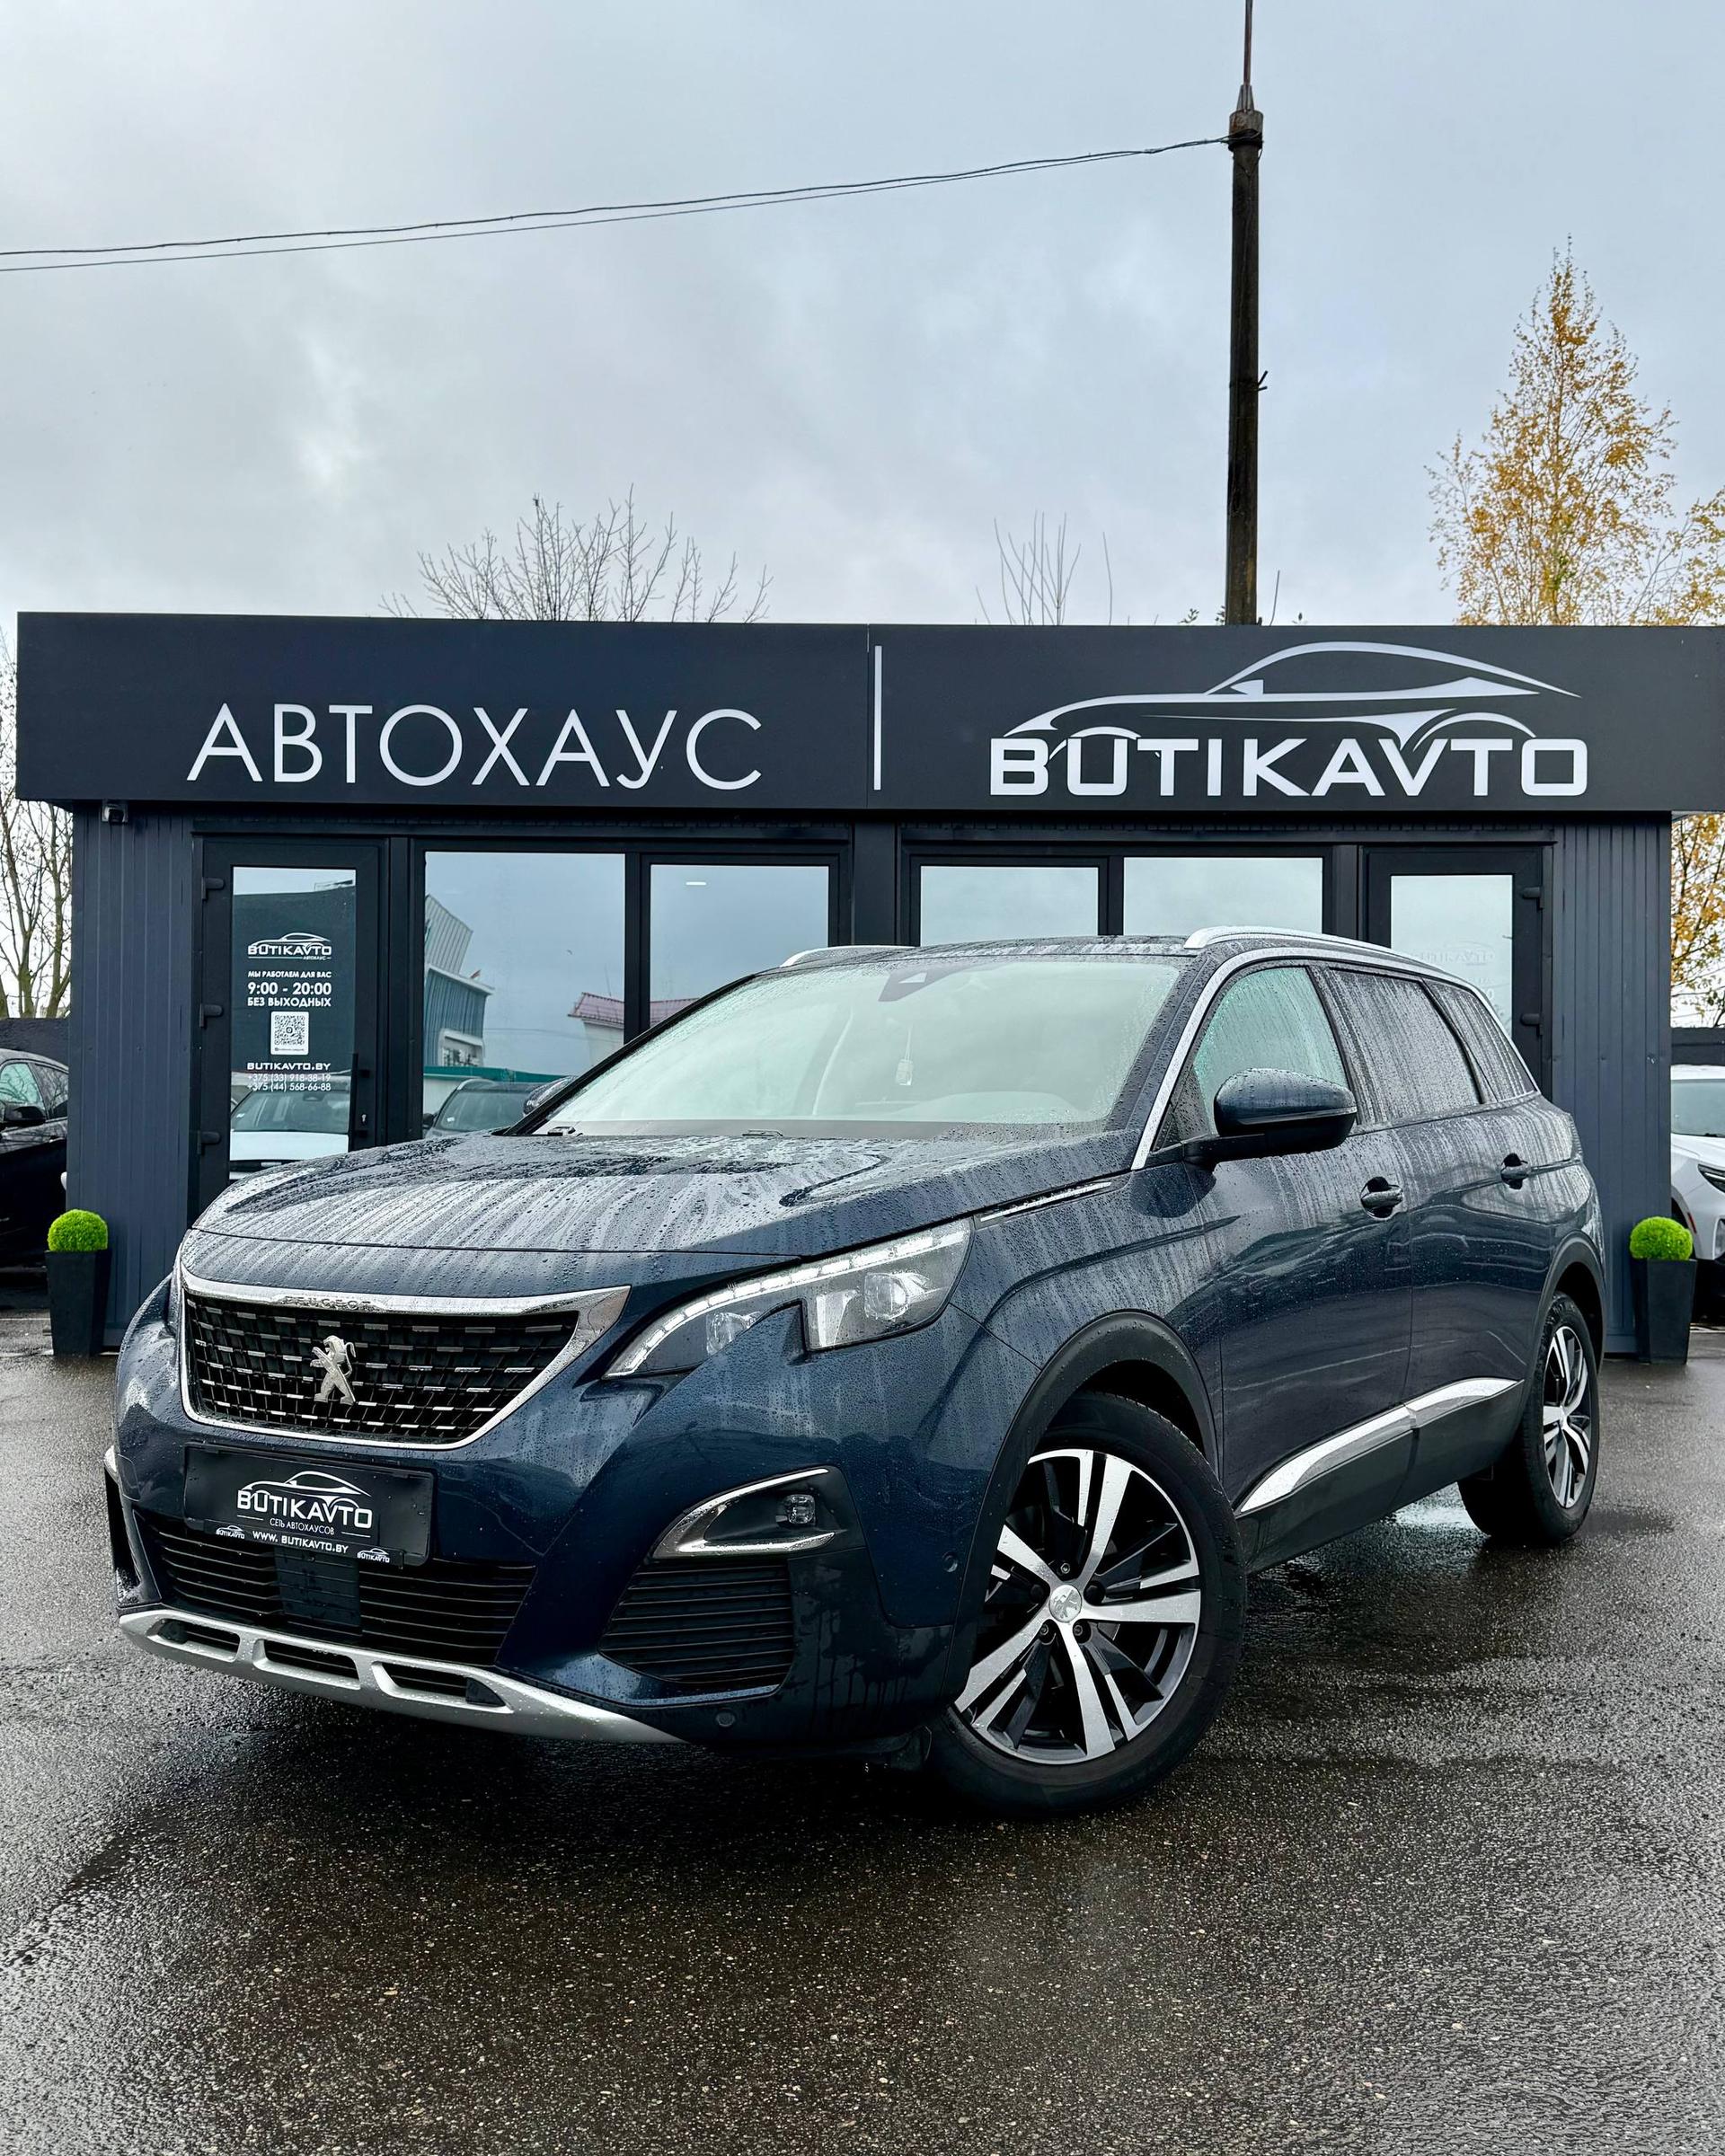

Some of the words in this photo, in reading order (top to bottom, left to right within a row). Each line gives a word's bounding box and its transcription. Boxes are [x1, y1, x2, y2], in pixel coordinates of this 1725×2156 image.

[186, 702, 762, 791] АВТОХАУС
[990, 738, 1588, 797] BUTIKAVTO
[248, 945, 332, 956] BUTIKAVTO
[247, 982, 278, 995] 9:00
[292, 982, 332, 995] 20:00
[247, 997, 265, 1007] БЕЗ
[268, 997, 332, 1008] ВЫХОДНЫХ
[247, 1063, 331, 1071] BUTIKAVTO.BY
[247, 1082, 269, 1091] +375
[270, 1082, 287, 1092] (44)
[282, 1294, 375, 1311] PEUGEOT
[236, 1489, 373, 1529] BUTIKAVTO
[270, 1517, 286, 1528] СЕТЬ
[286, 1521, 335, 1535] АВТОХАУСОВ
[216, 1530, 245, 1540] BUTIKAVTO
[357, 1552, 390, 1564] BUTIKAVTO
